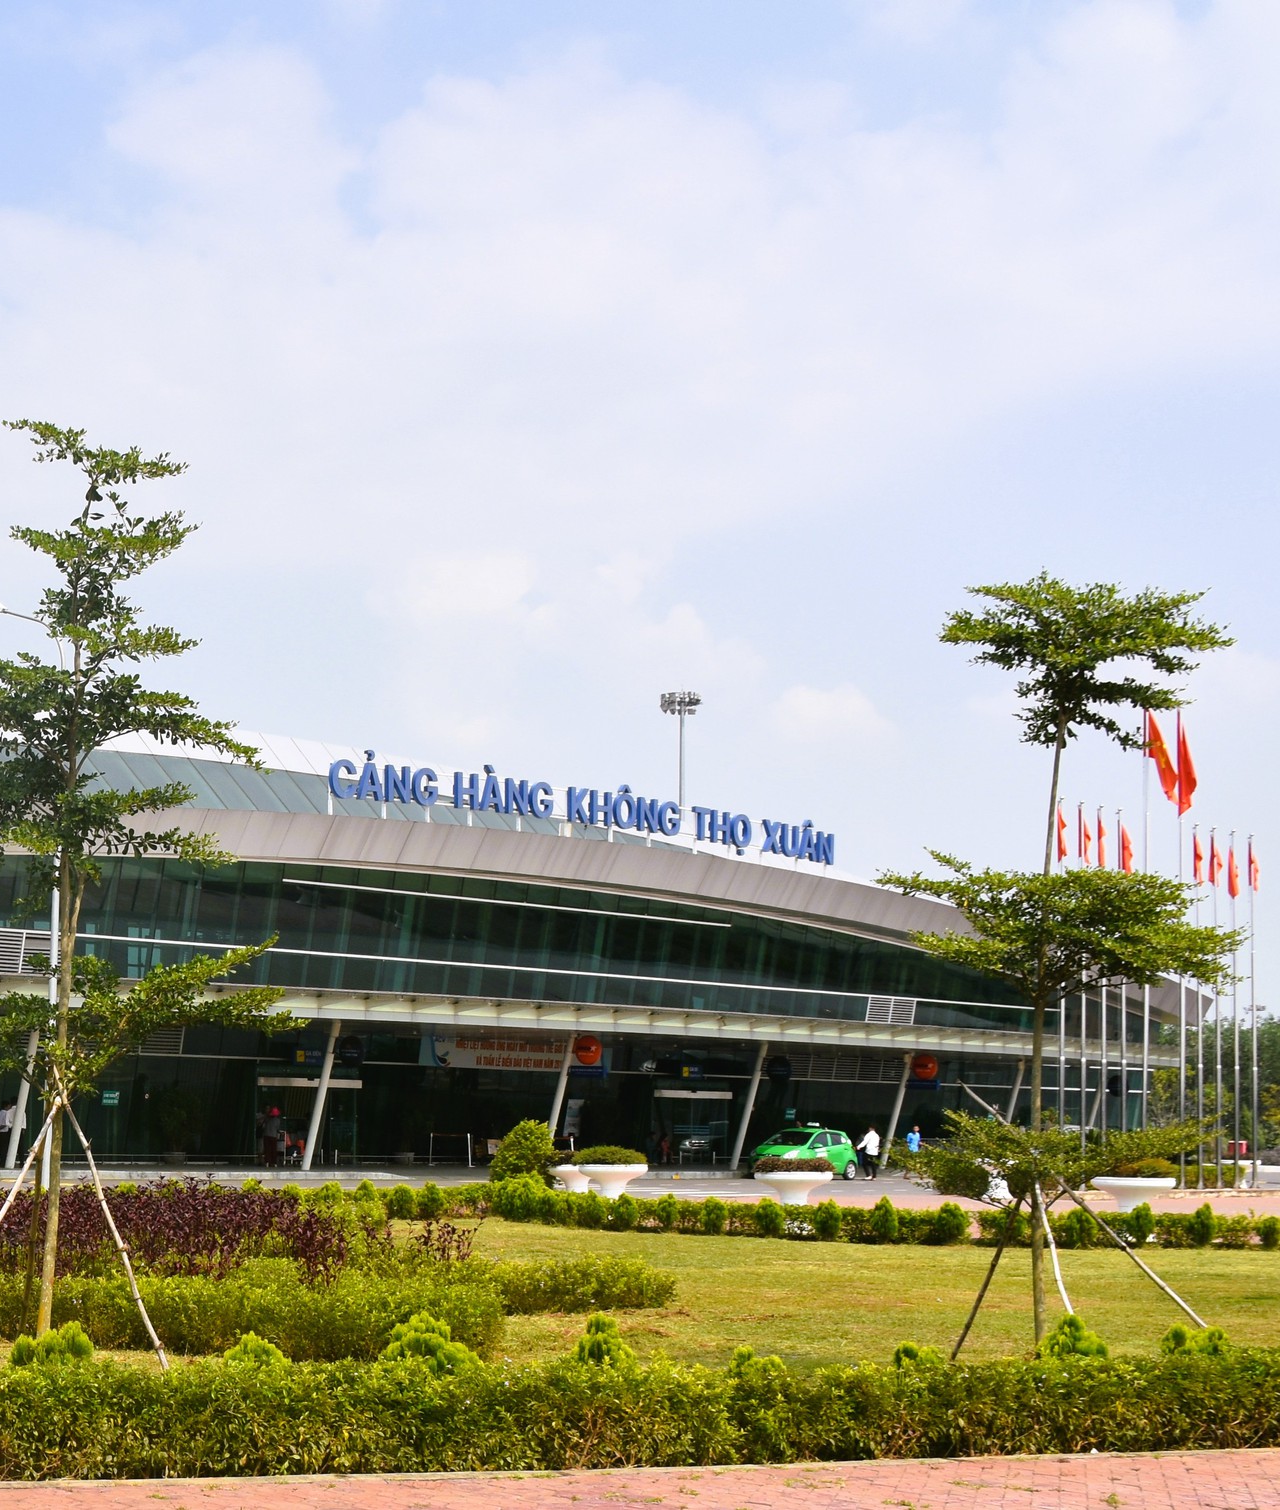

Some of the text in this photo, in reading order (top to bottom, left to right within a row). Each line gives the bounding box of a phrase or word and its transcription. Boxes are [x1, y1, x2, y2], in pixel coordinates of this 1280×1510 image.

[329, 750, 835, 866] CẢNG HÀNG KHÔNG THỌ XUÂN
